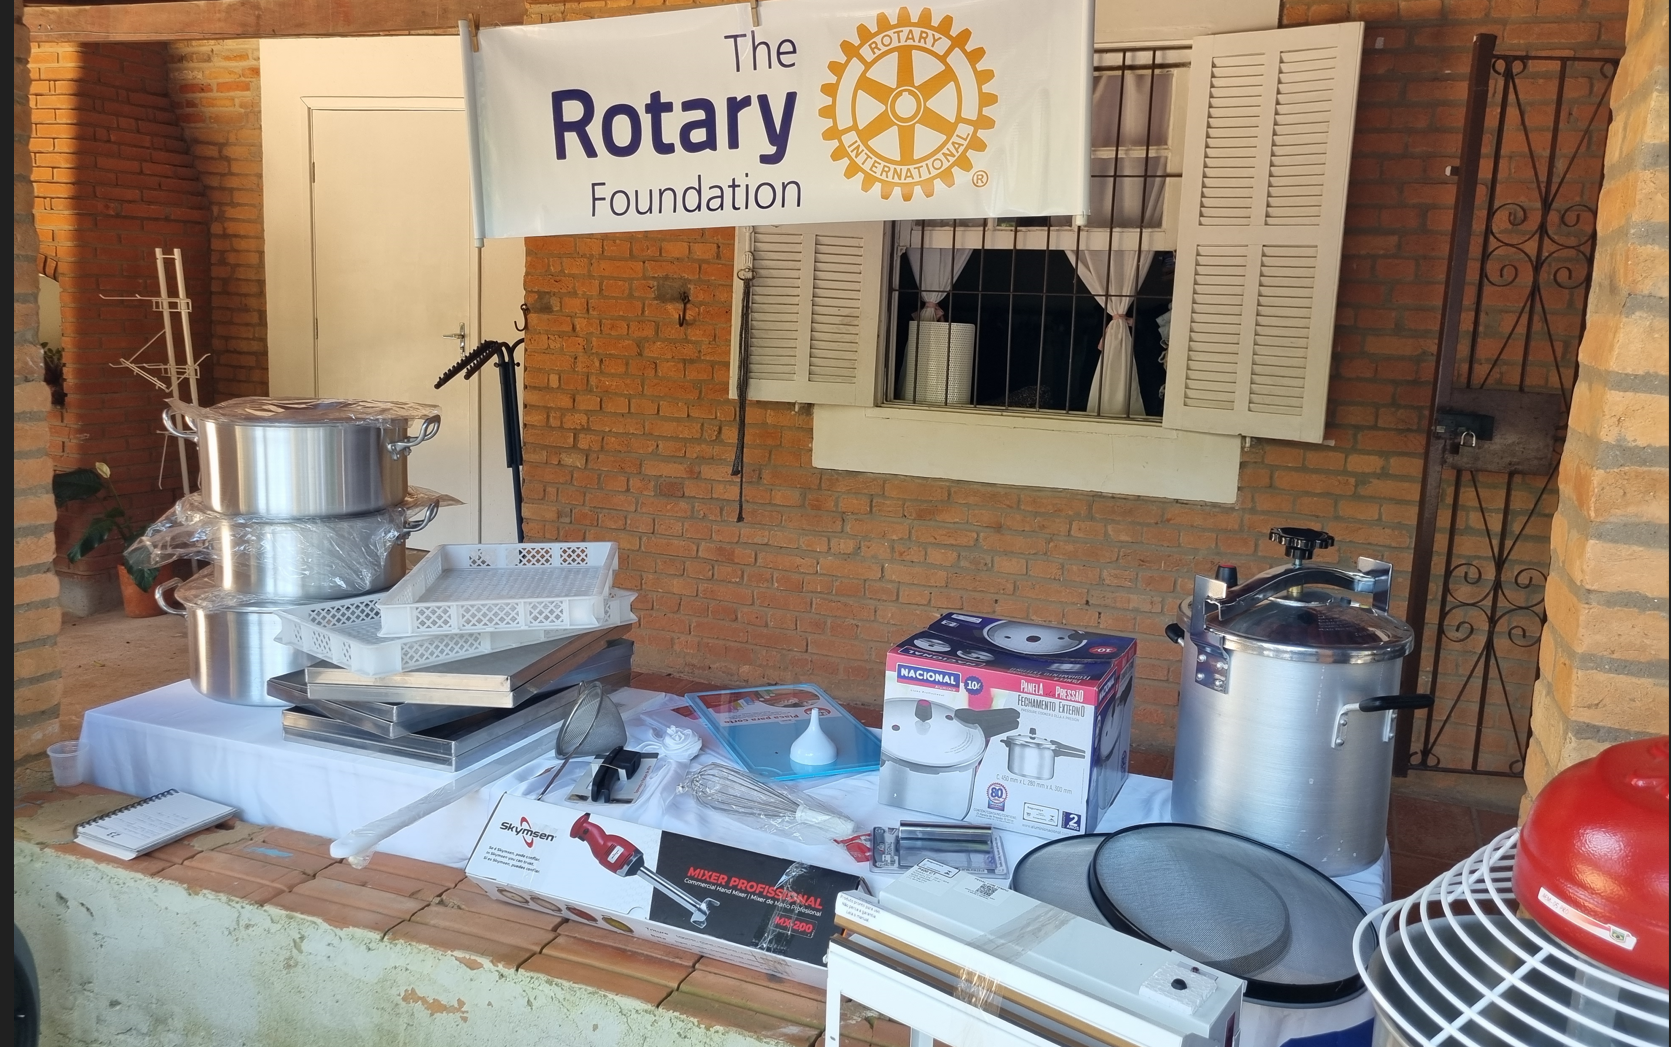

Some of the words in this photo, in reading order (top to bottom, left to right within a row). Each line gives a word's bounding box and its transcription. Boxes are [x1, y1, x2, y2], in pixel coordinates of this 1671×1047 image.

[723, 30, 798, 73] The
[868, 29, 942, 56] ROTARY
[551, 88, 798, 165] Rotary
[847, 132, 970, 181] INTERNATIONAL
[590, 172, 803, 217] Foundation
[900, 667, 956, 685] NACIONAL
[1020, 679, 1044, 695] PANELA
[1055, 686, 1084, 703] PRESSÃO
[1017, 694, 1056, 712] FECHAMENTO
[1058, 701, 1085, 718] EXTERNO
[990, 787, 1003, 798] 80
[499, 821, 555, 842] Skymsen
[1068, 814, 1079, 827] 2
[684, 877, 716, 890] Commercial
[716, 885, 732, 894] Hand
[732, 889, 747, 898] Mixer
[750, 895, 766, 903] Mixer
[687, 866, 728, 885] MIXER
[729, 877, 823, 909] PROFISSIONAL
[774, 916, 813, 933] MX-200
